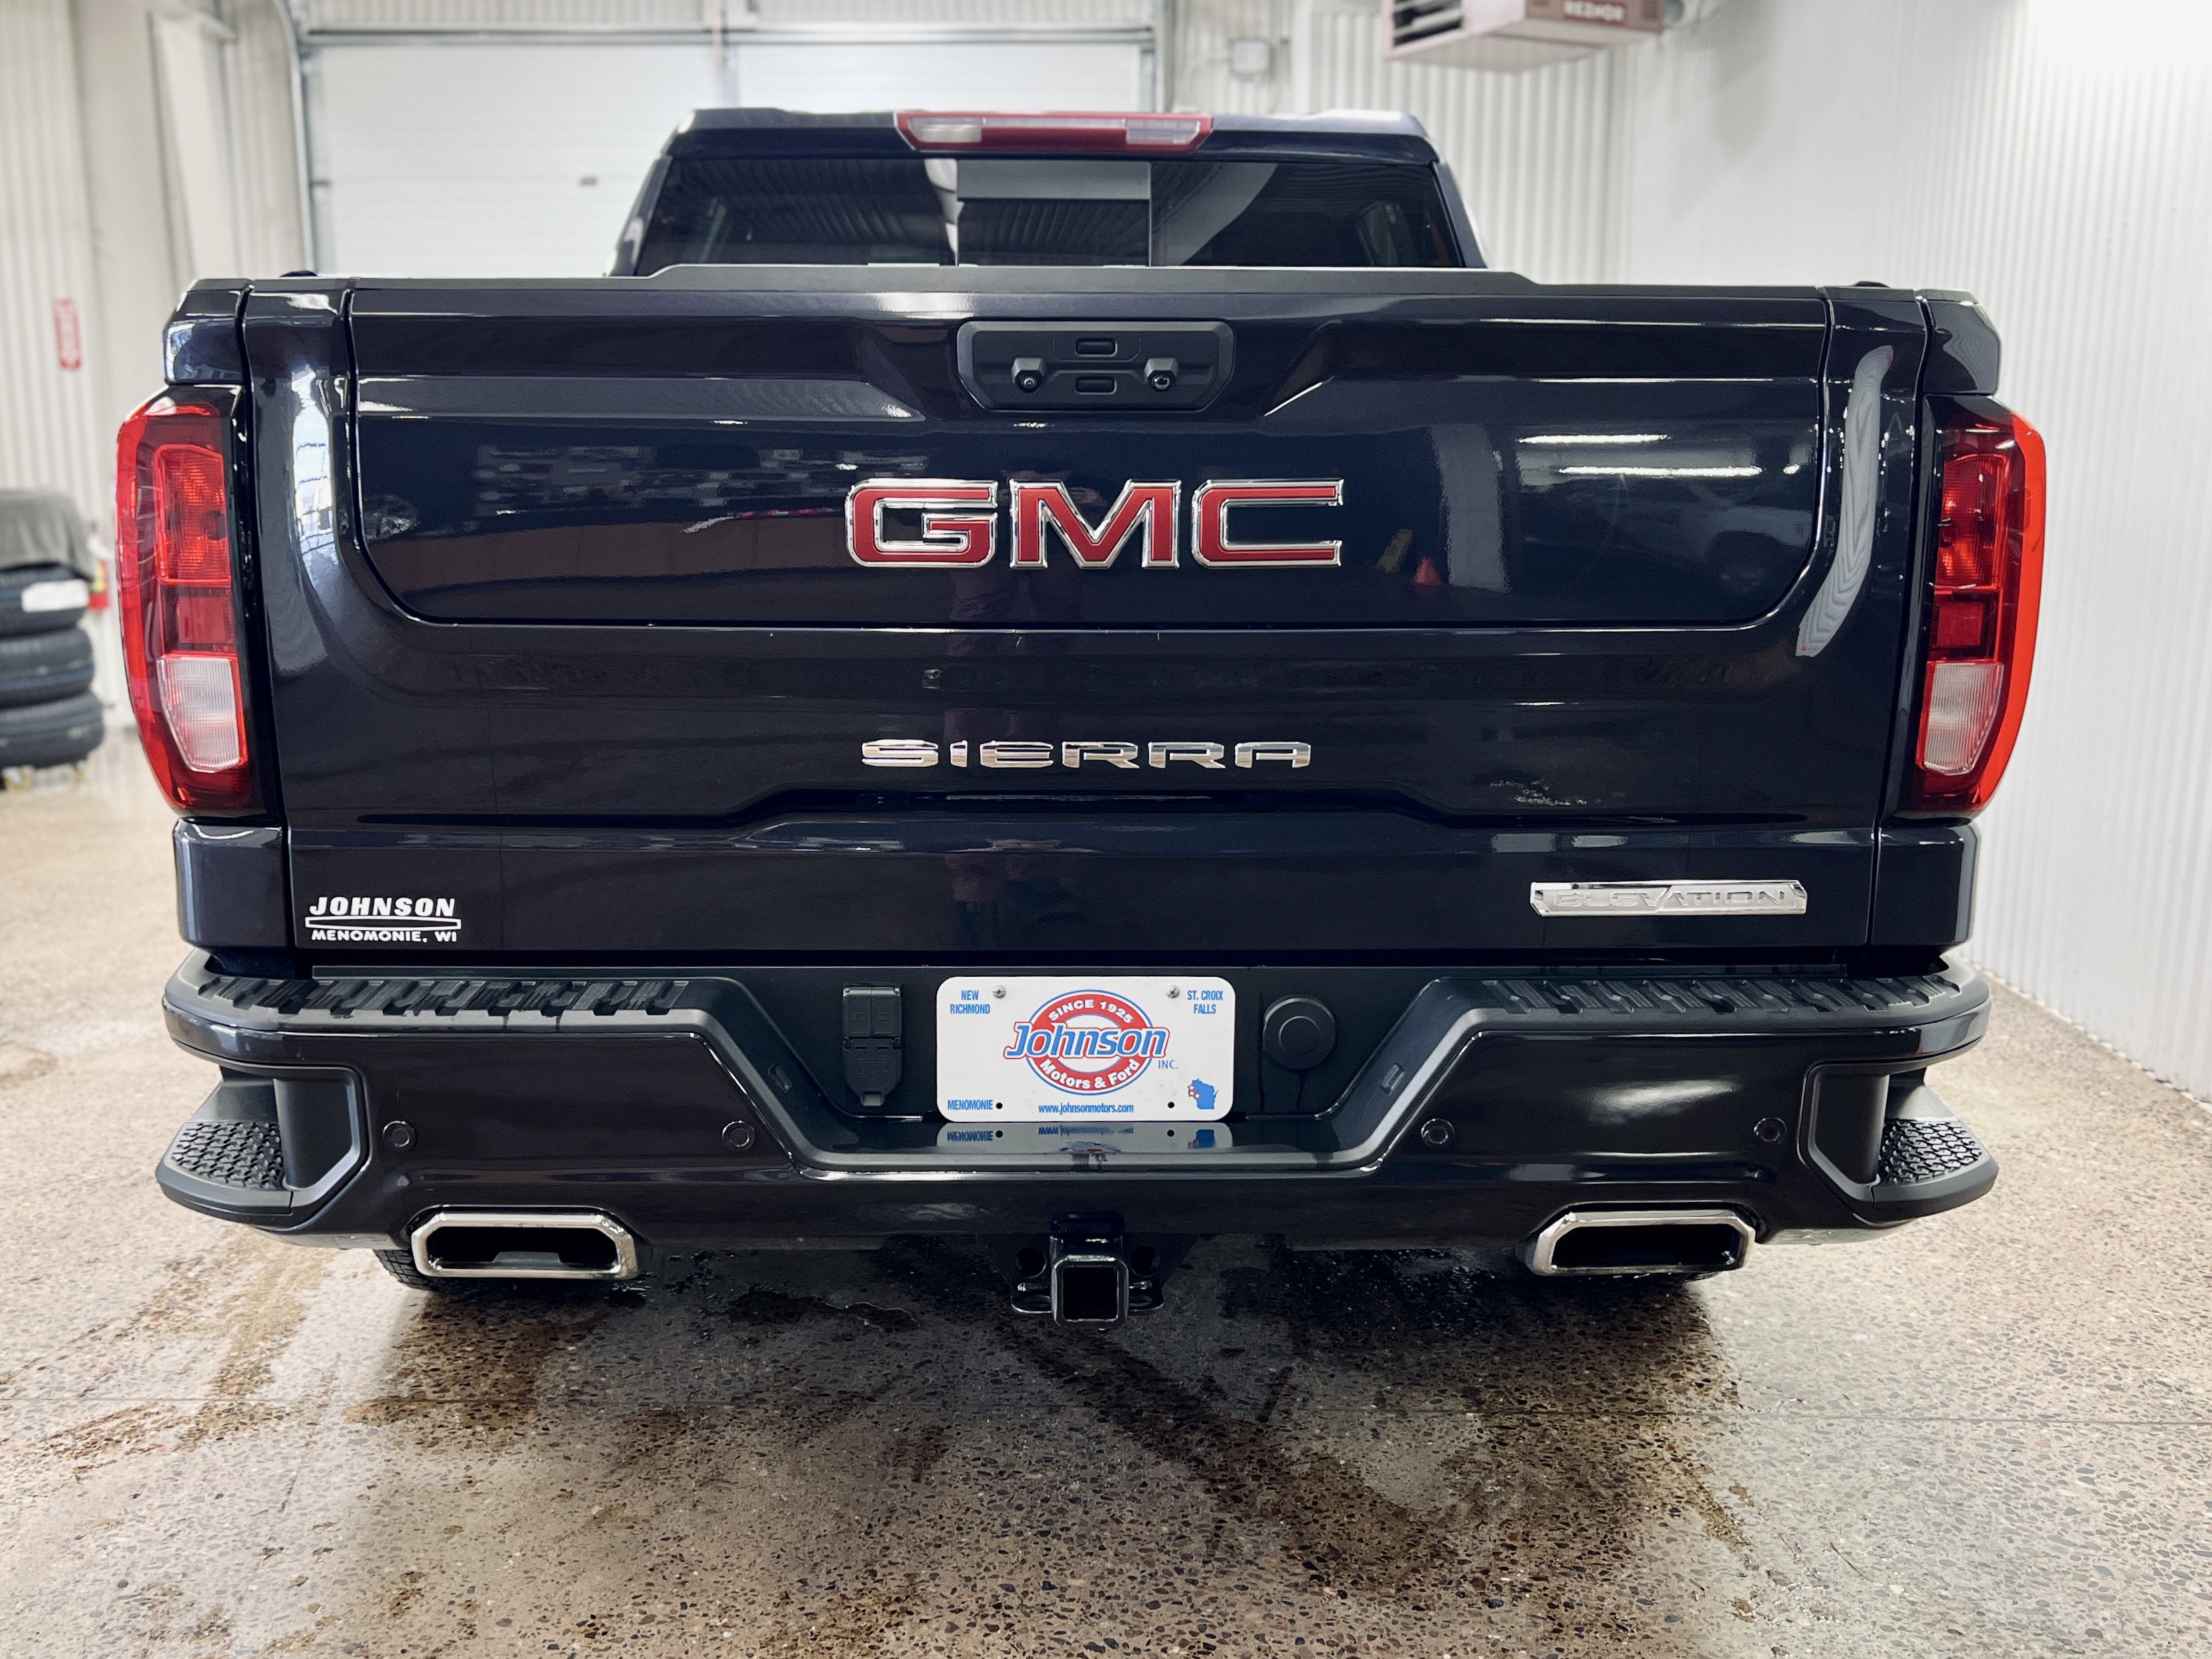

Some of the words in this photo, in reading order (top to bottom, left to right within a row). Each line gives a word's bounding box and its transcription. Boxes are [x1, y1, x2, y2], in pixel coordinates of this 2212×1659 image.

[845, 478, 1344, 569] GMC
[862, 739, 1311, 769] SIERRA
[1553, 891, 1784, 907] ELEVATION
[309, 897, 455, 917] JOHNSON
[311, 930, 428, 943] MENOMONIE,
[435, 931, 457, 942] WI
[961, 990, 979, 1001] NEW
[1187, 990, 1199, 1001] ST.
[1201, 990, 1223, 1001] CROIX
[949, 1004, 990, 1014] RICHMOND
[1048, 999, 1094, 1022] SINCE
[1100, 1001, 1133, 1024] 1925
[1194, 1004, 1217, 1014] FALLS
[1005, 1024, 1168, 1057] Johnson
[1158, 1059, 1178, 1070] INC.
[1039, 1059, 1091, 1090] Motors
[1094, 1077, 1106, 1090] &
[1108, 1059, 1140, 1087] Ford
[947, 1100, 993, 1110] MENOMONIE
[1038, 1102, 1134, 1114] www.johnsonmotors.com
